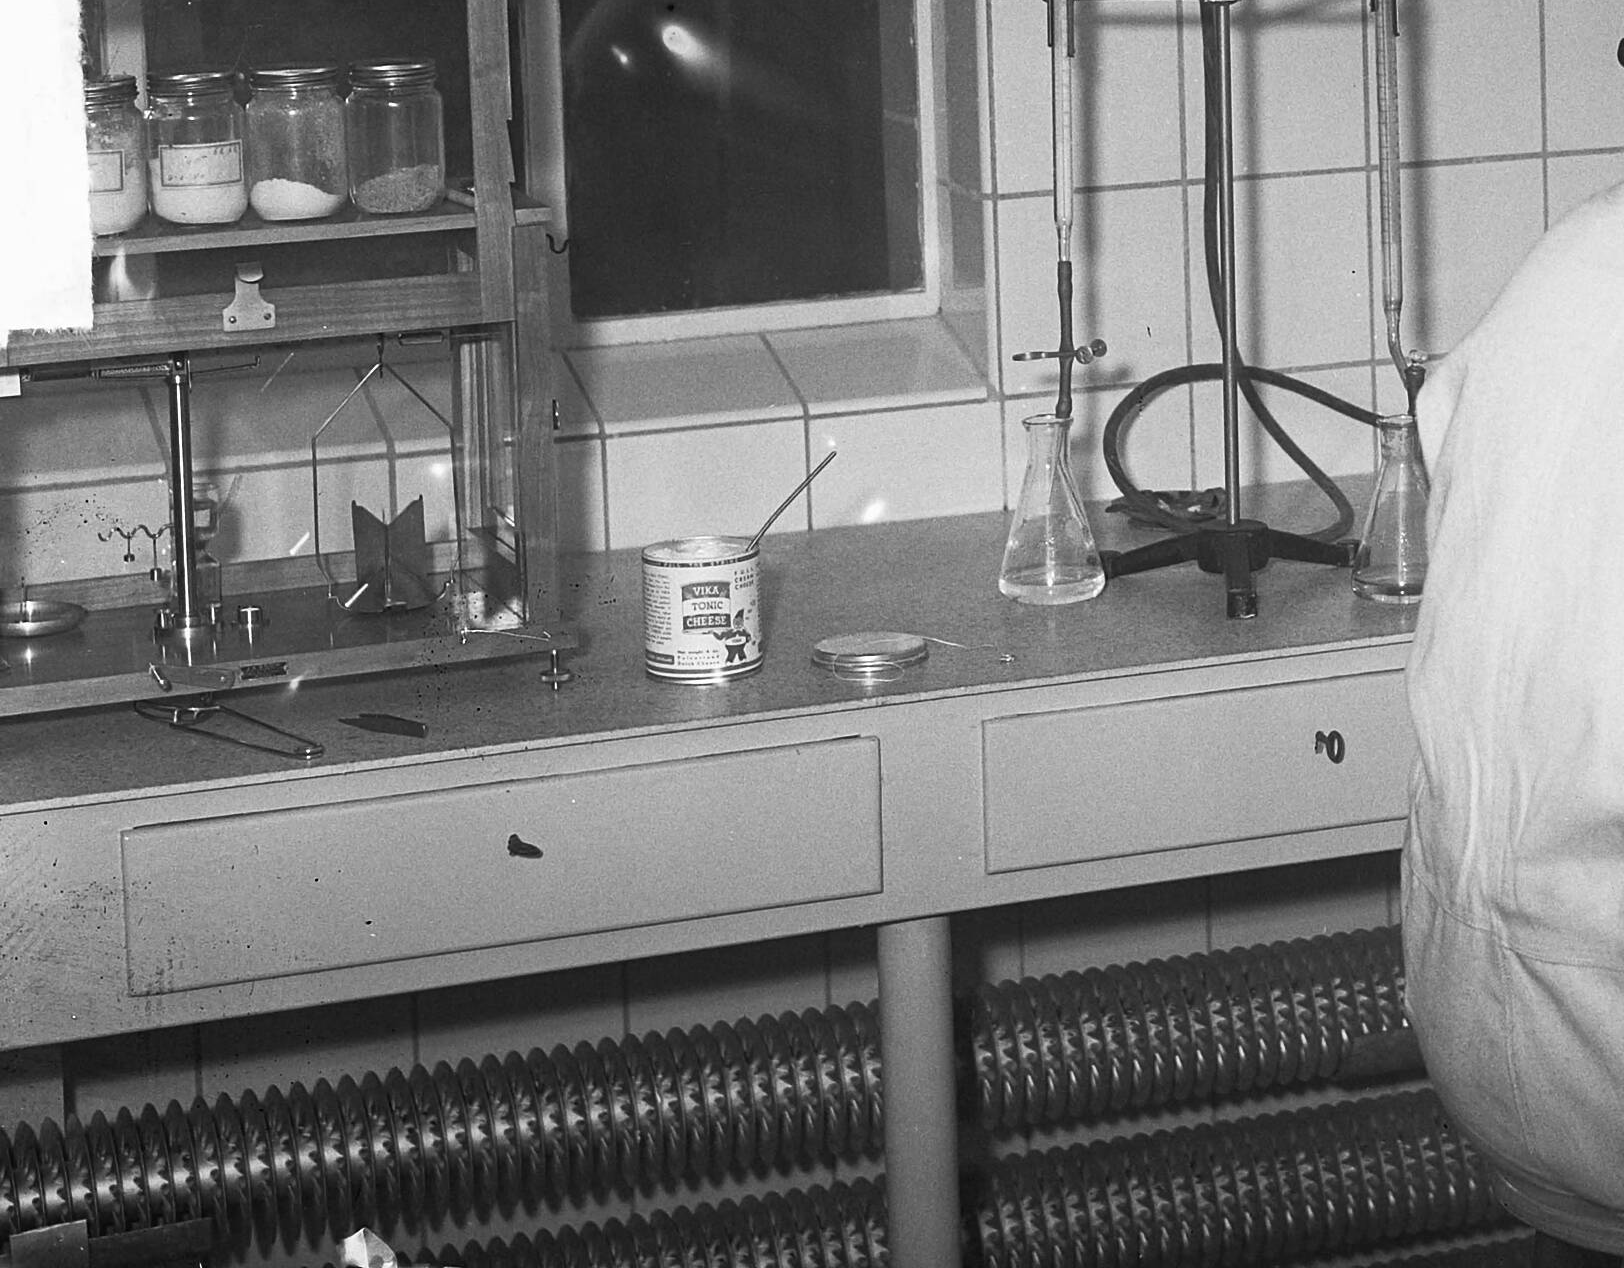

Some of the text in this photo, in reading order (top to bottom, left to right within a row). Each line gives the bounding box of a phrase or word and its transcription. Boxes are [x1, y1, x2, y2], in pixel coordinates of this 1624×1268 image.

[693, 586, 719, 596] VIKA
[692, 601, 723, 611] TONIC
[686, 616, 727, 627] CHEESE
